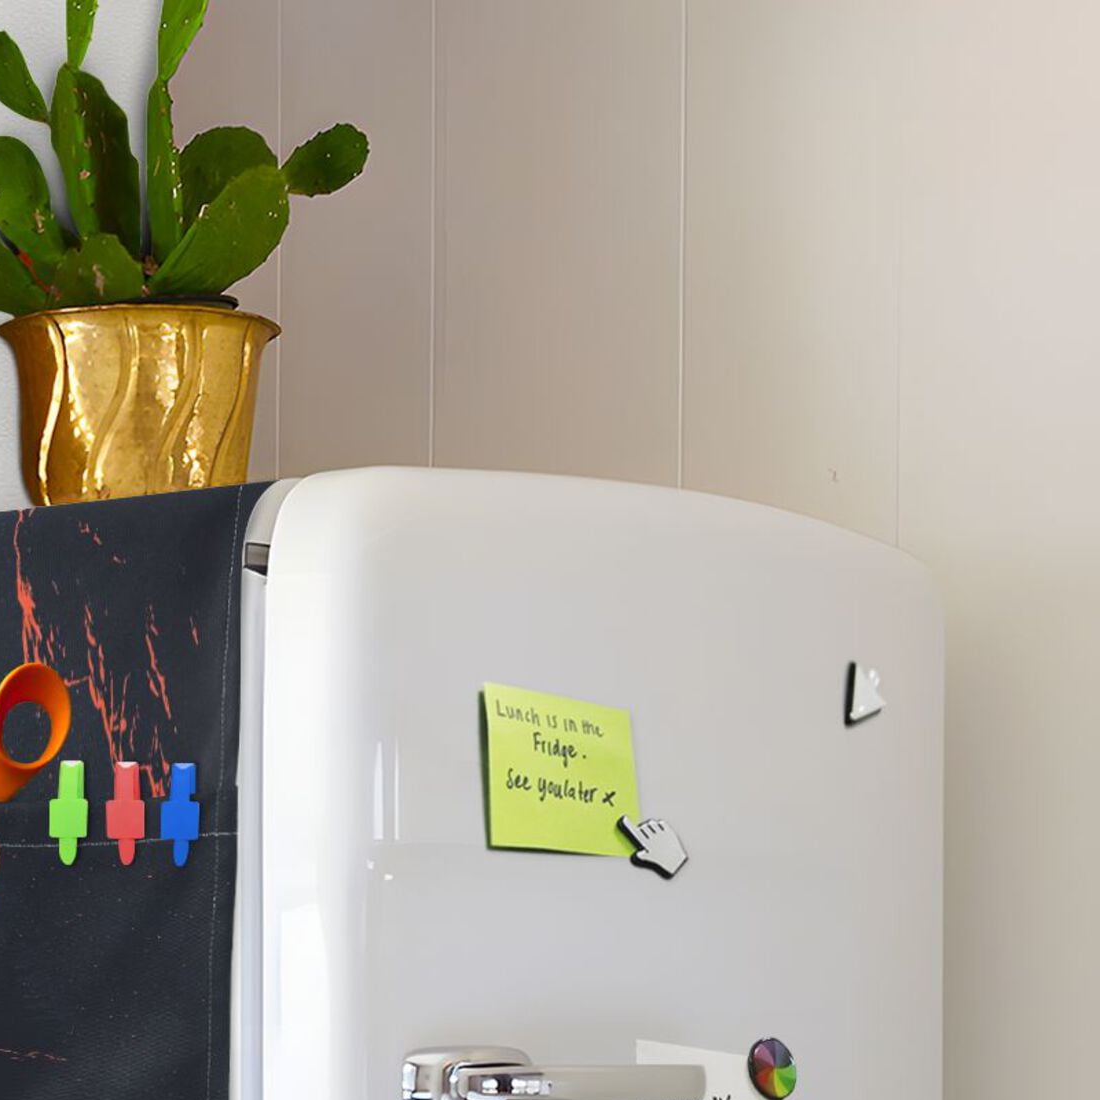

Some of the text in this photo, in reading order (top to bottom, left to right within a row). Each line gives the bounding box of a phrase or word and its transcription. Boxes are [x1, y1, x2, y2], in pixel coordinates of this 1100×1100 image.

[496, 699, 541, 728] Lunch
[563, 718, 578, 733] in
[581, 719, 604, 738] the
[505, 767, 532, 790] See
